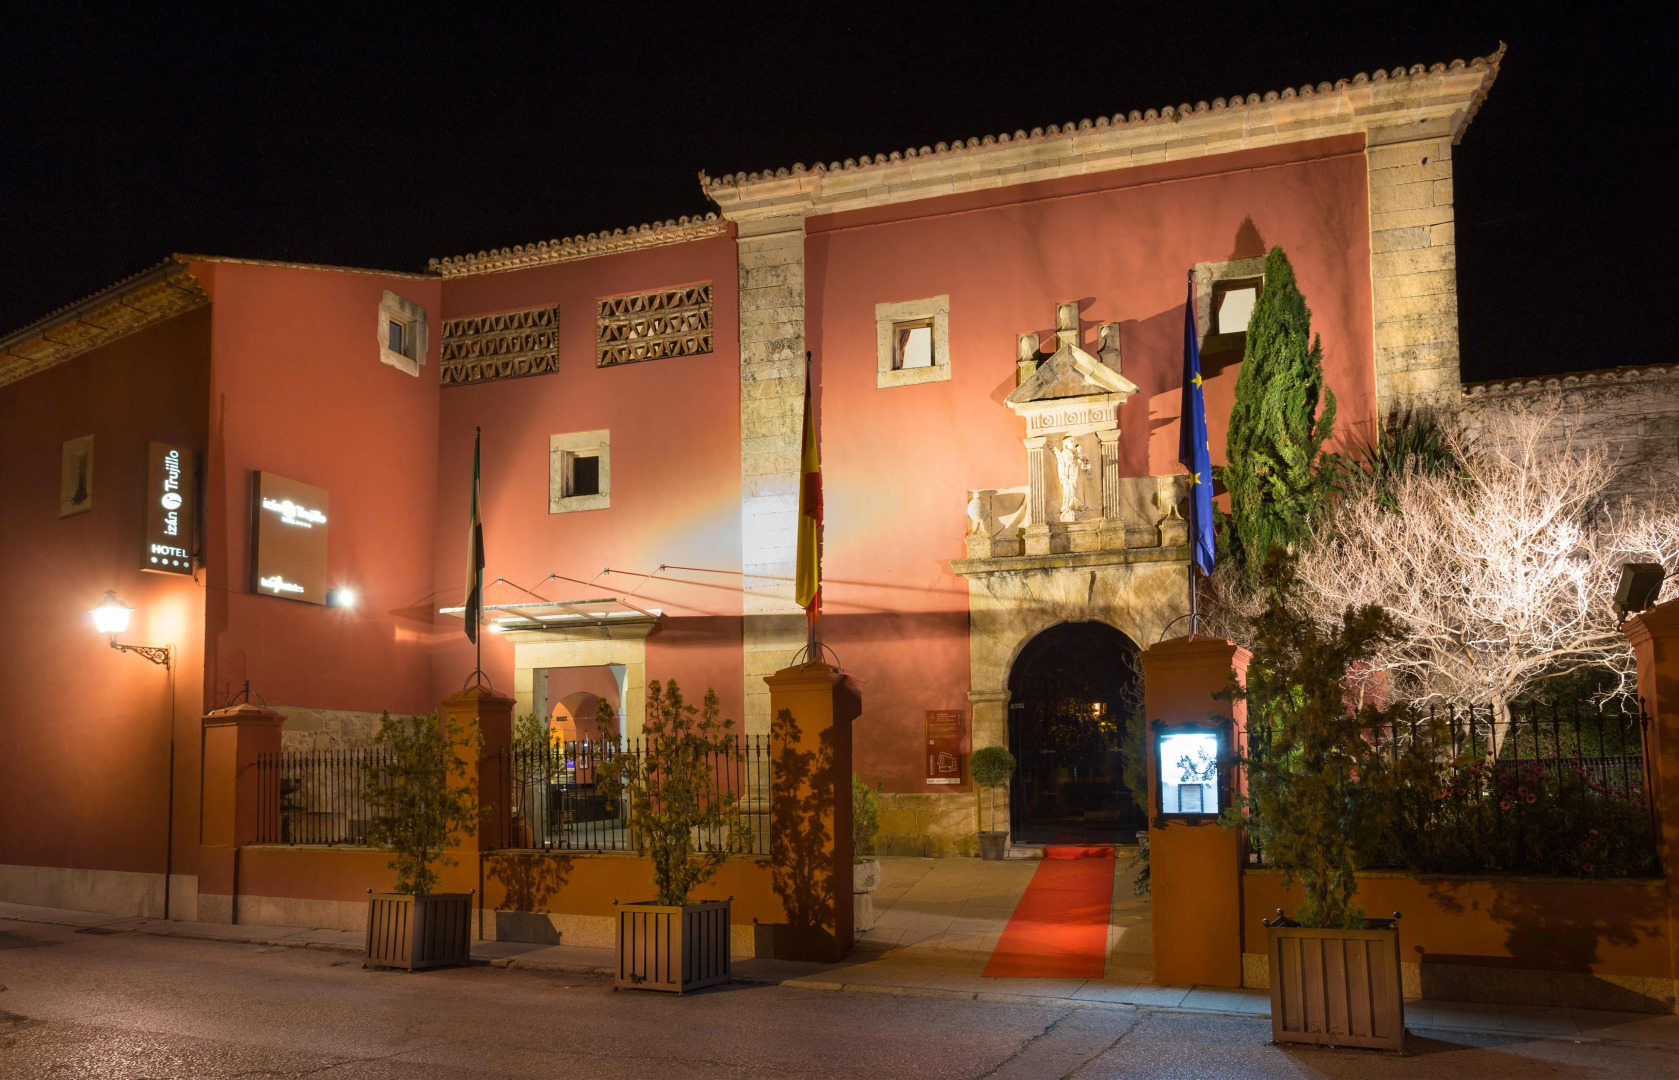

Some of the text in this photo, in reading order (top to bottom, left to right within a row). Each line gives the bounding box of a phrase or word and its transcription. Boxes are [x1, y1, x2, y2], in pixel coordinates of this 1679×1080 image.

[164, 450, 180, 536] izán Trujillo
[151, 544, 188, 558] HOTEL
